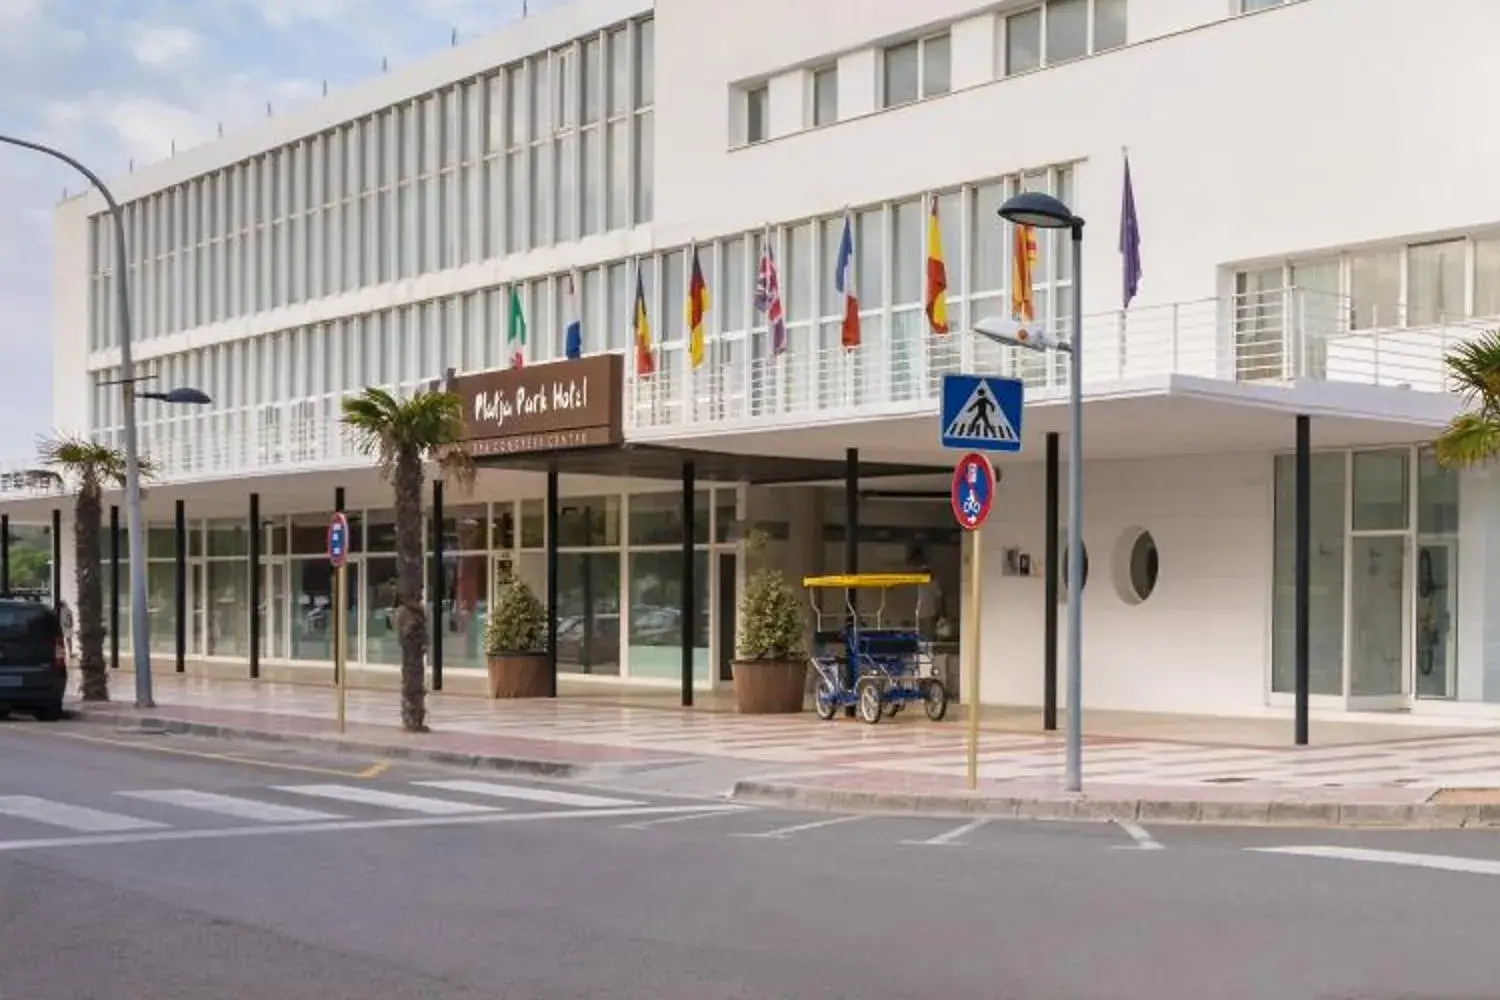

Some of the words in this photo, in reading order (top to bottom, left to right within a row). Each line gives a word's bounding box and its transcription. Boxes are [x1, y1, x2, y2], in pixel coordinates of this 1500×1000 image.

[475, 390, 512, 426] Platja
[516, 384, 548, 416] Park
[553, 376, 588, 411] Hotel
